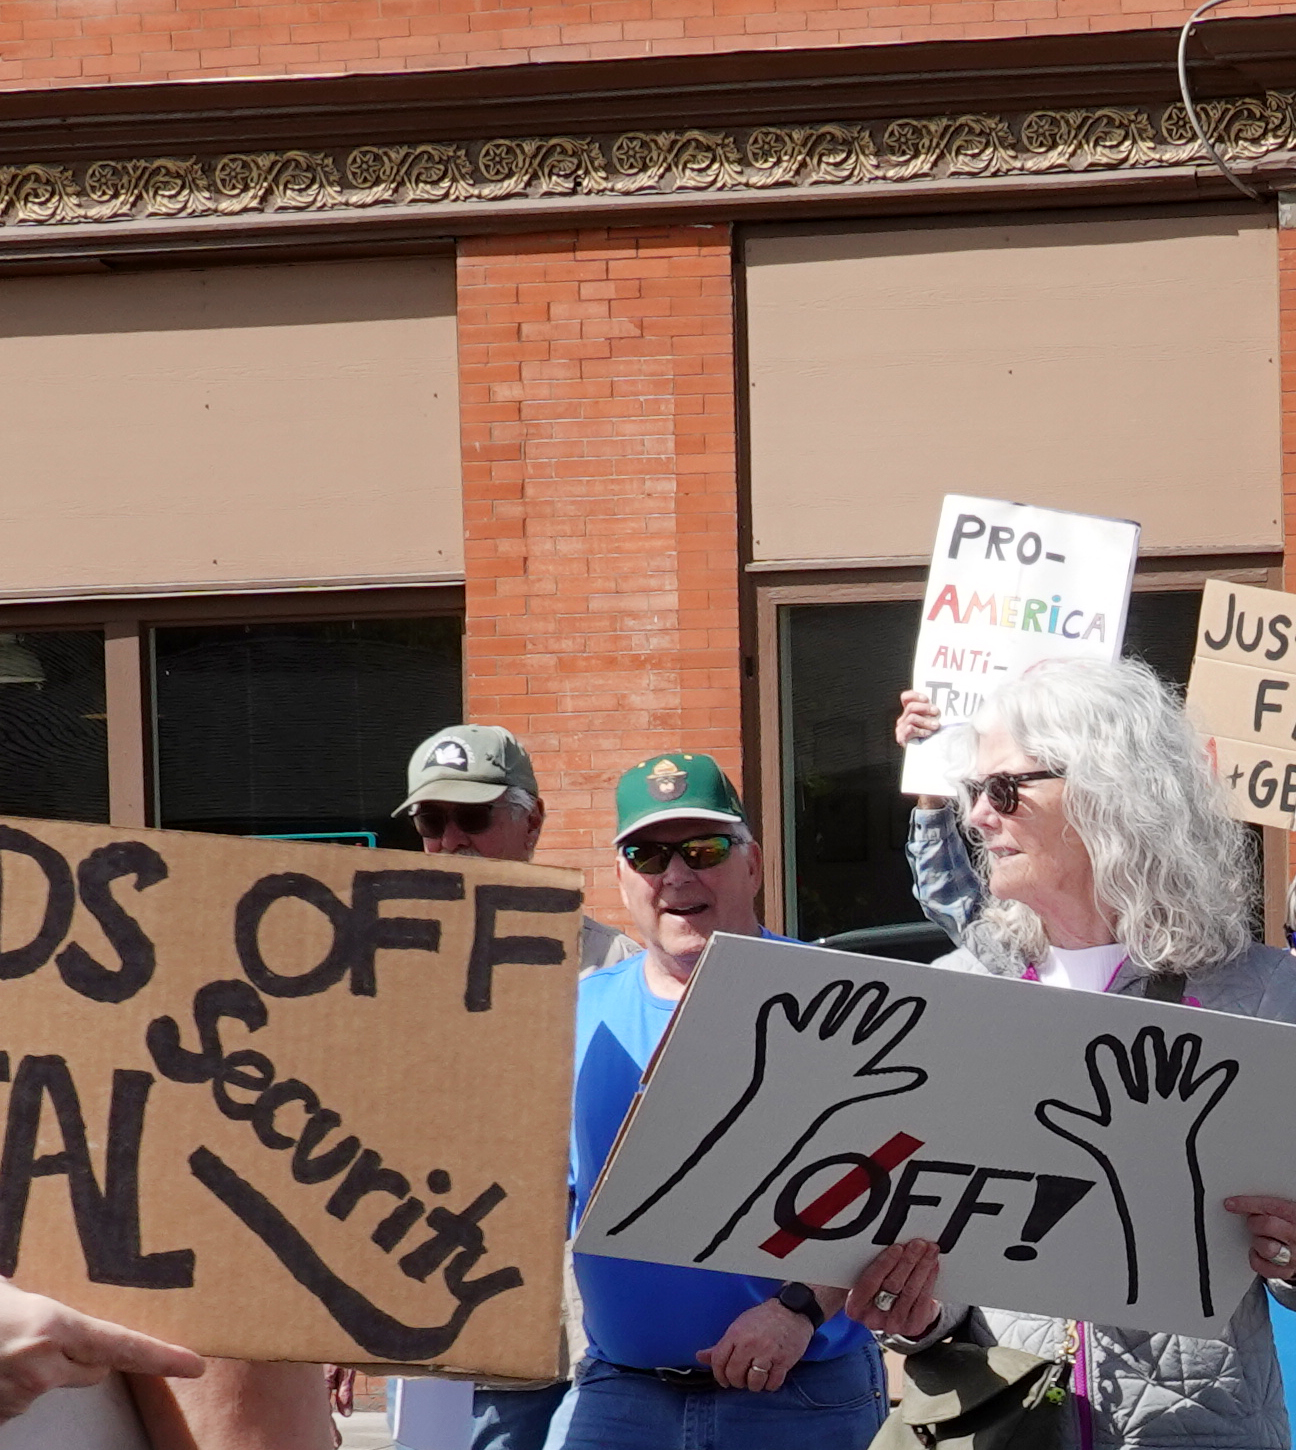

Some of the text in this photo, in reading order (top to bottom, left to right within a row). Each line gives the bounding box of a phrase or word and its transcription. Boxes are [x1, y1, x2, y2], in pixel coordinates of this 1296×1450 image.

[948, 513, 1066, 566] PRO-
[234, 869, 583, 1012] OFF
[772, 1150, 1097, 1262] OFF!
